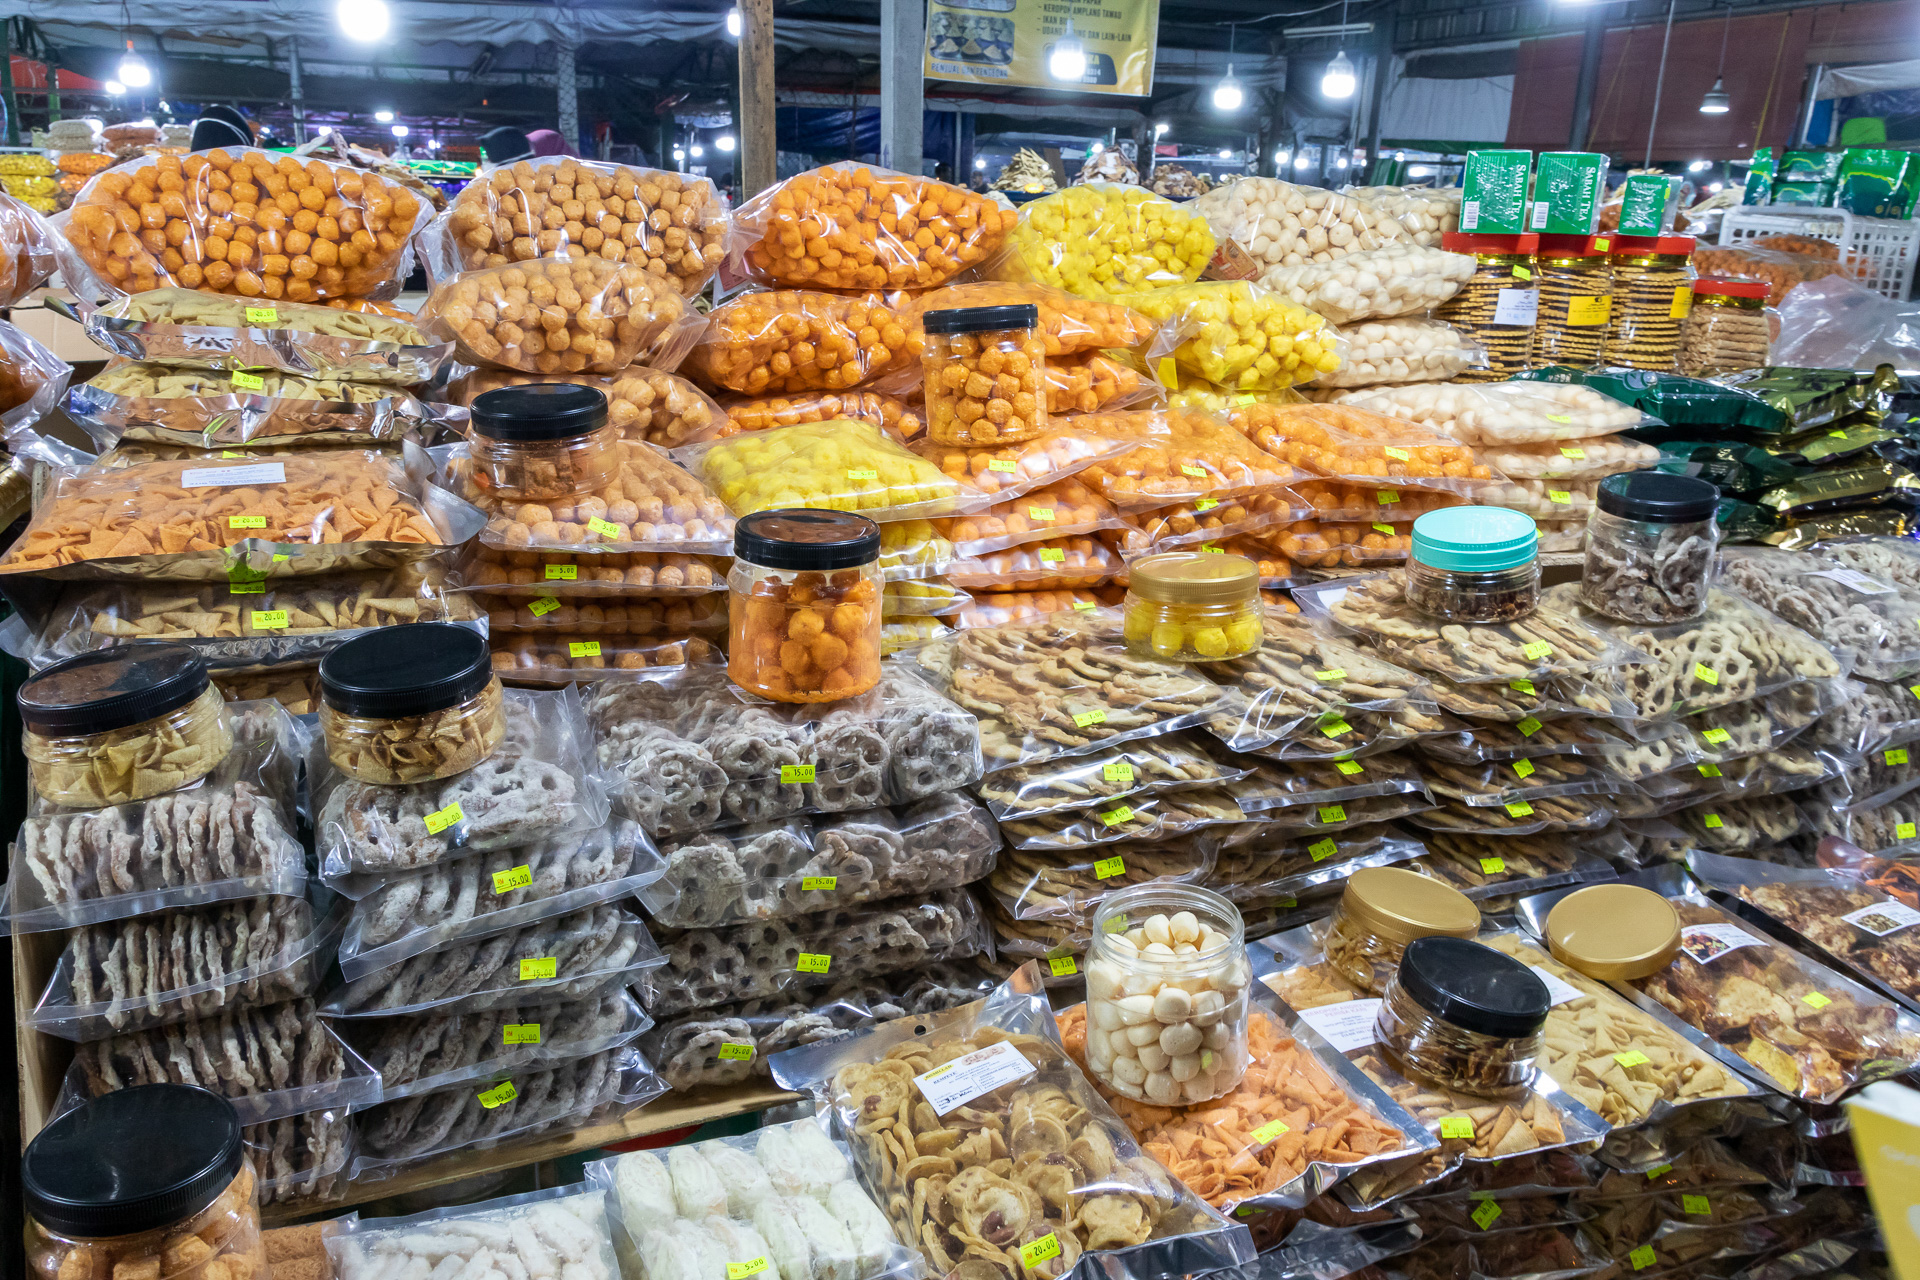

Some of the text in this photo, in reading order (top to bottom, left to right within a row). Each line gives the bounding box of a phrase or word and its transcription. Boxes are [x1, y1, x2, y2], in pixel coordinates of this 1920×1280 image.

[1073, 7, 1100, 17] AMPLANG
[1043, 15, 1058, 24] IKAN
[1042, 26, 1063, 36] UDANG
[1088, 31, 1100, 39] DAN
[1101, 32, 1132, 42] LAIN-LAIN
[1510, 164, 1527, 221] SABAH TEA
[1578, 166, 1597, 222] SABAH TEA
[603, 523, 617, 533] 5.00
[543, 598, 556, 607] 5.00
[264, 613, 285, 621] 20.00
[794, 769, 813, 777] 15.00
[444, 812, 460, 826] 7.00
[1331, 811, 1344, 819] 7.00
[1322, 844, 1335, 855] 7.00
[1107, 860, 1122, 868] 7.00
[509, 874, 530, 887] 15.00
[810, 959, 828, 967] 15.00
[1060, 960, 1074, 968] 7.00
[533, 969, 553, 977] 15.00
[496, 1089, 515, 1102] 15.00
[1033, 1239, 1055, 1257] 20.00
[744, 1259, 763, 1270] 5.00
